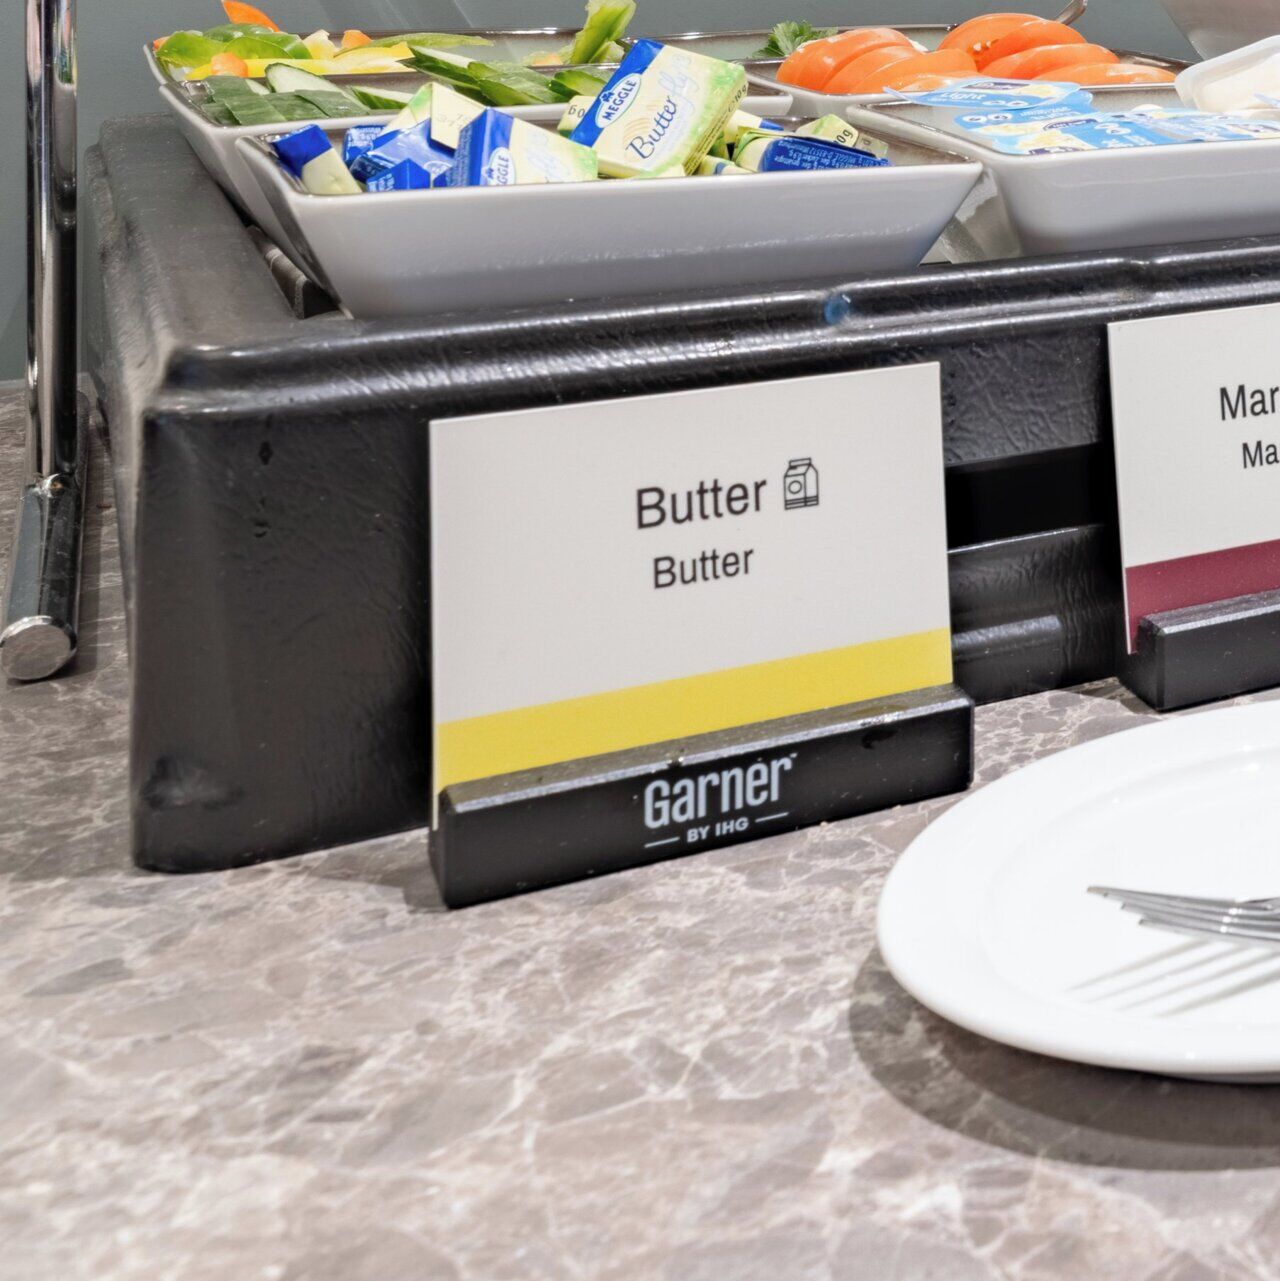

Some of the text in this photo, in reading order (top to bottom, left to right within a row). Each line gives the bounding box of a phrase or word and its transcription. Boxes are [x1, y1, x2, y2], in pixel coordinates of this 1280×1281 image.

[602, 78, 637, 121] MEGGLE
[497, 155, 509, 185] GGLE
[636, 478, 767, 530] Butter
[653, 548, 754, 590] Butter
[643, 757, 793, 829] Garner
[686, 817, 749, 844] BY IHG
